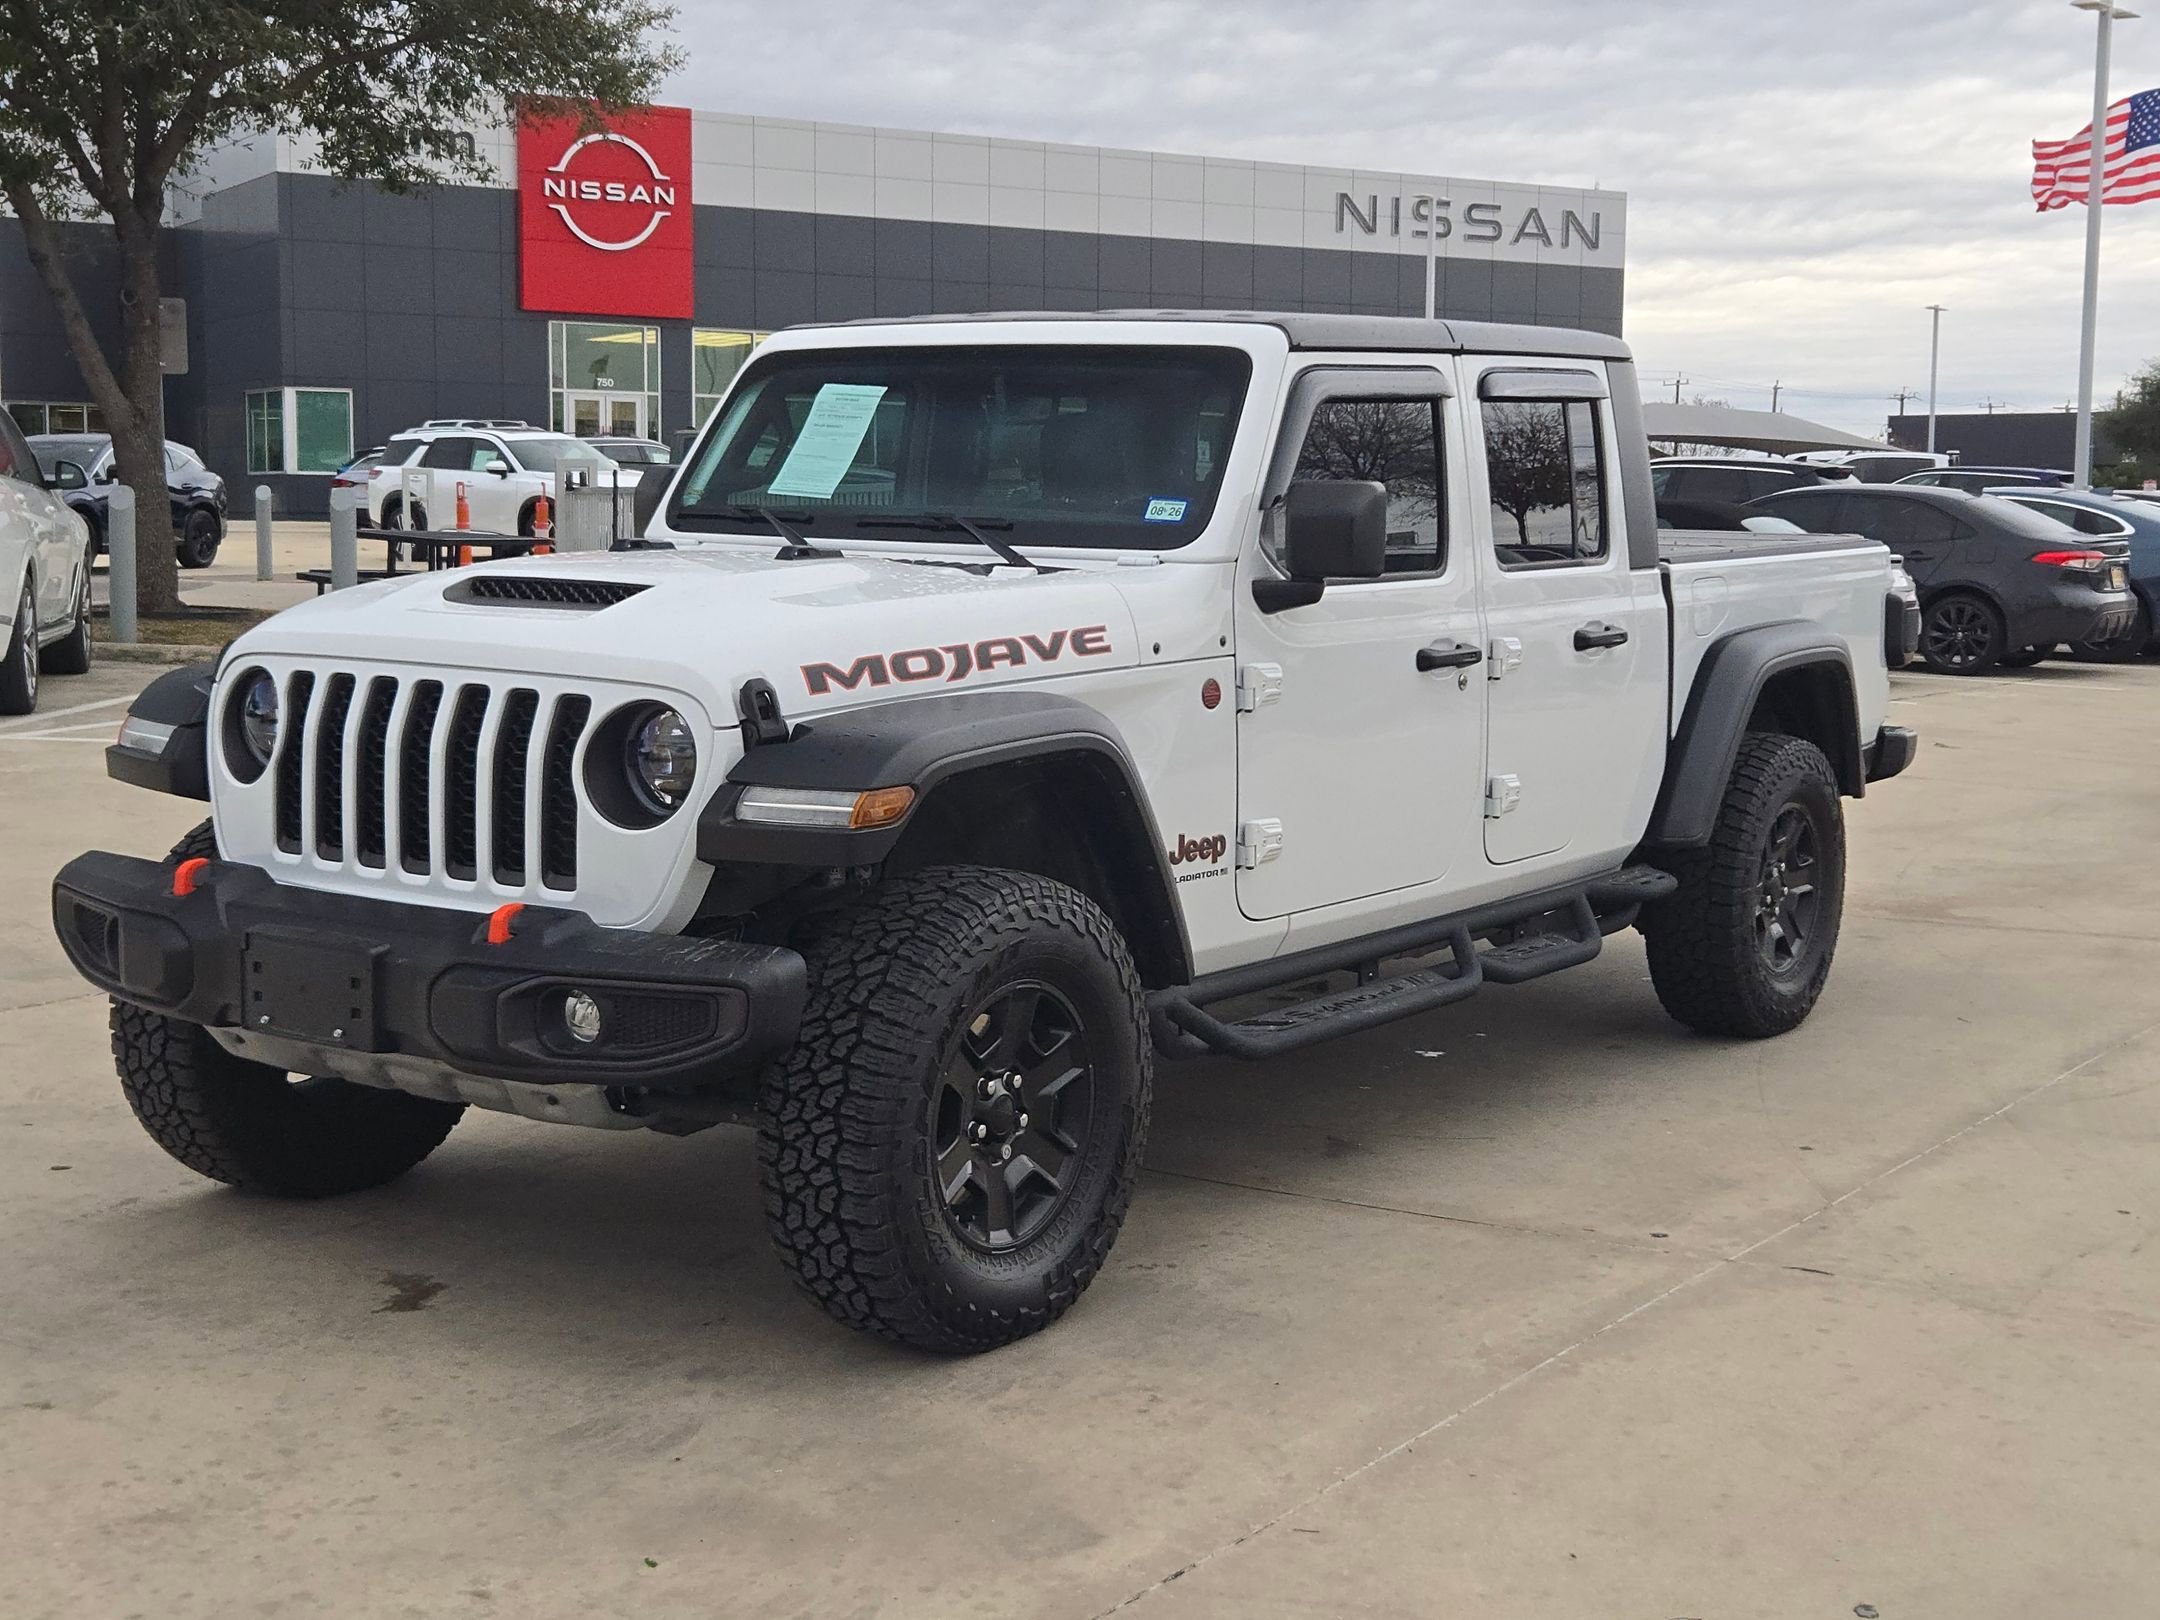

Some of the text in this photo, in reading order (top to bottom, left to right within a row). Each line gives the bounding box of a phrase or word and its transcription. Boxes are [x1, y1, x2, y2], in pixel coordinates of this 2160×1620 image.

[543, 178, 675, 205] NISSAN
[1335, 191, 1600, 250] NISSAN
[596, 377, 615, 388] 750
[1150, 506, 1182, 517] 08 26
[799, 624, 1112, 696] MOJAVE
[1168, 832, 1227, 866] Jeep
[1174, 869, 1219, 884] LADIATOR
